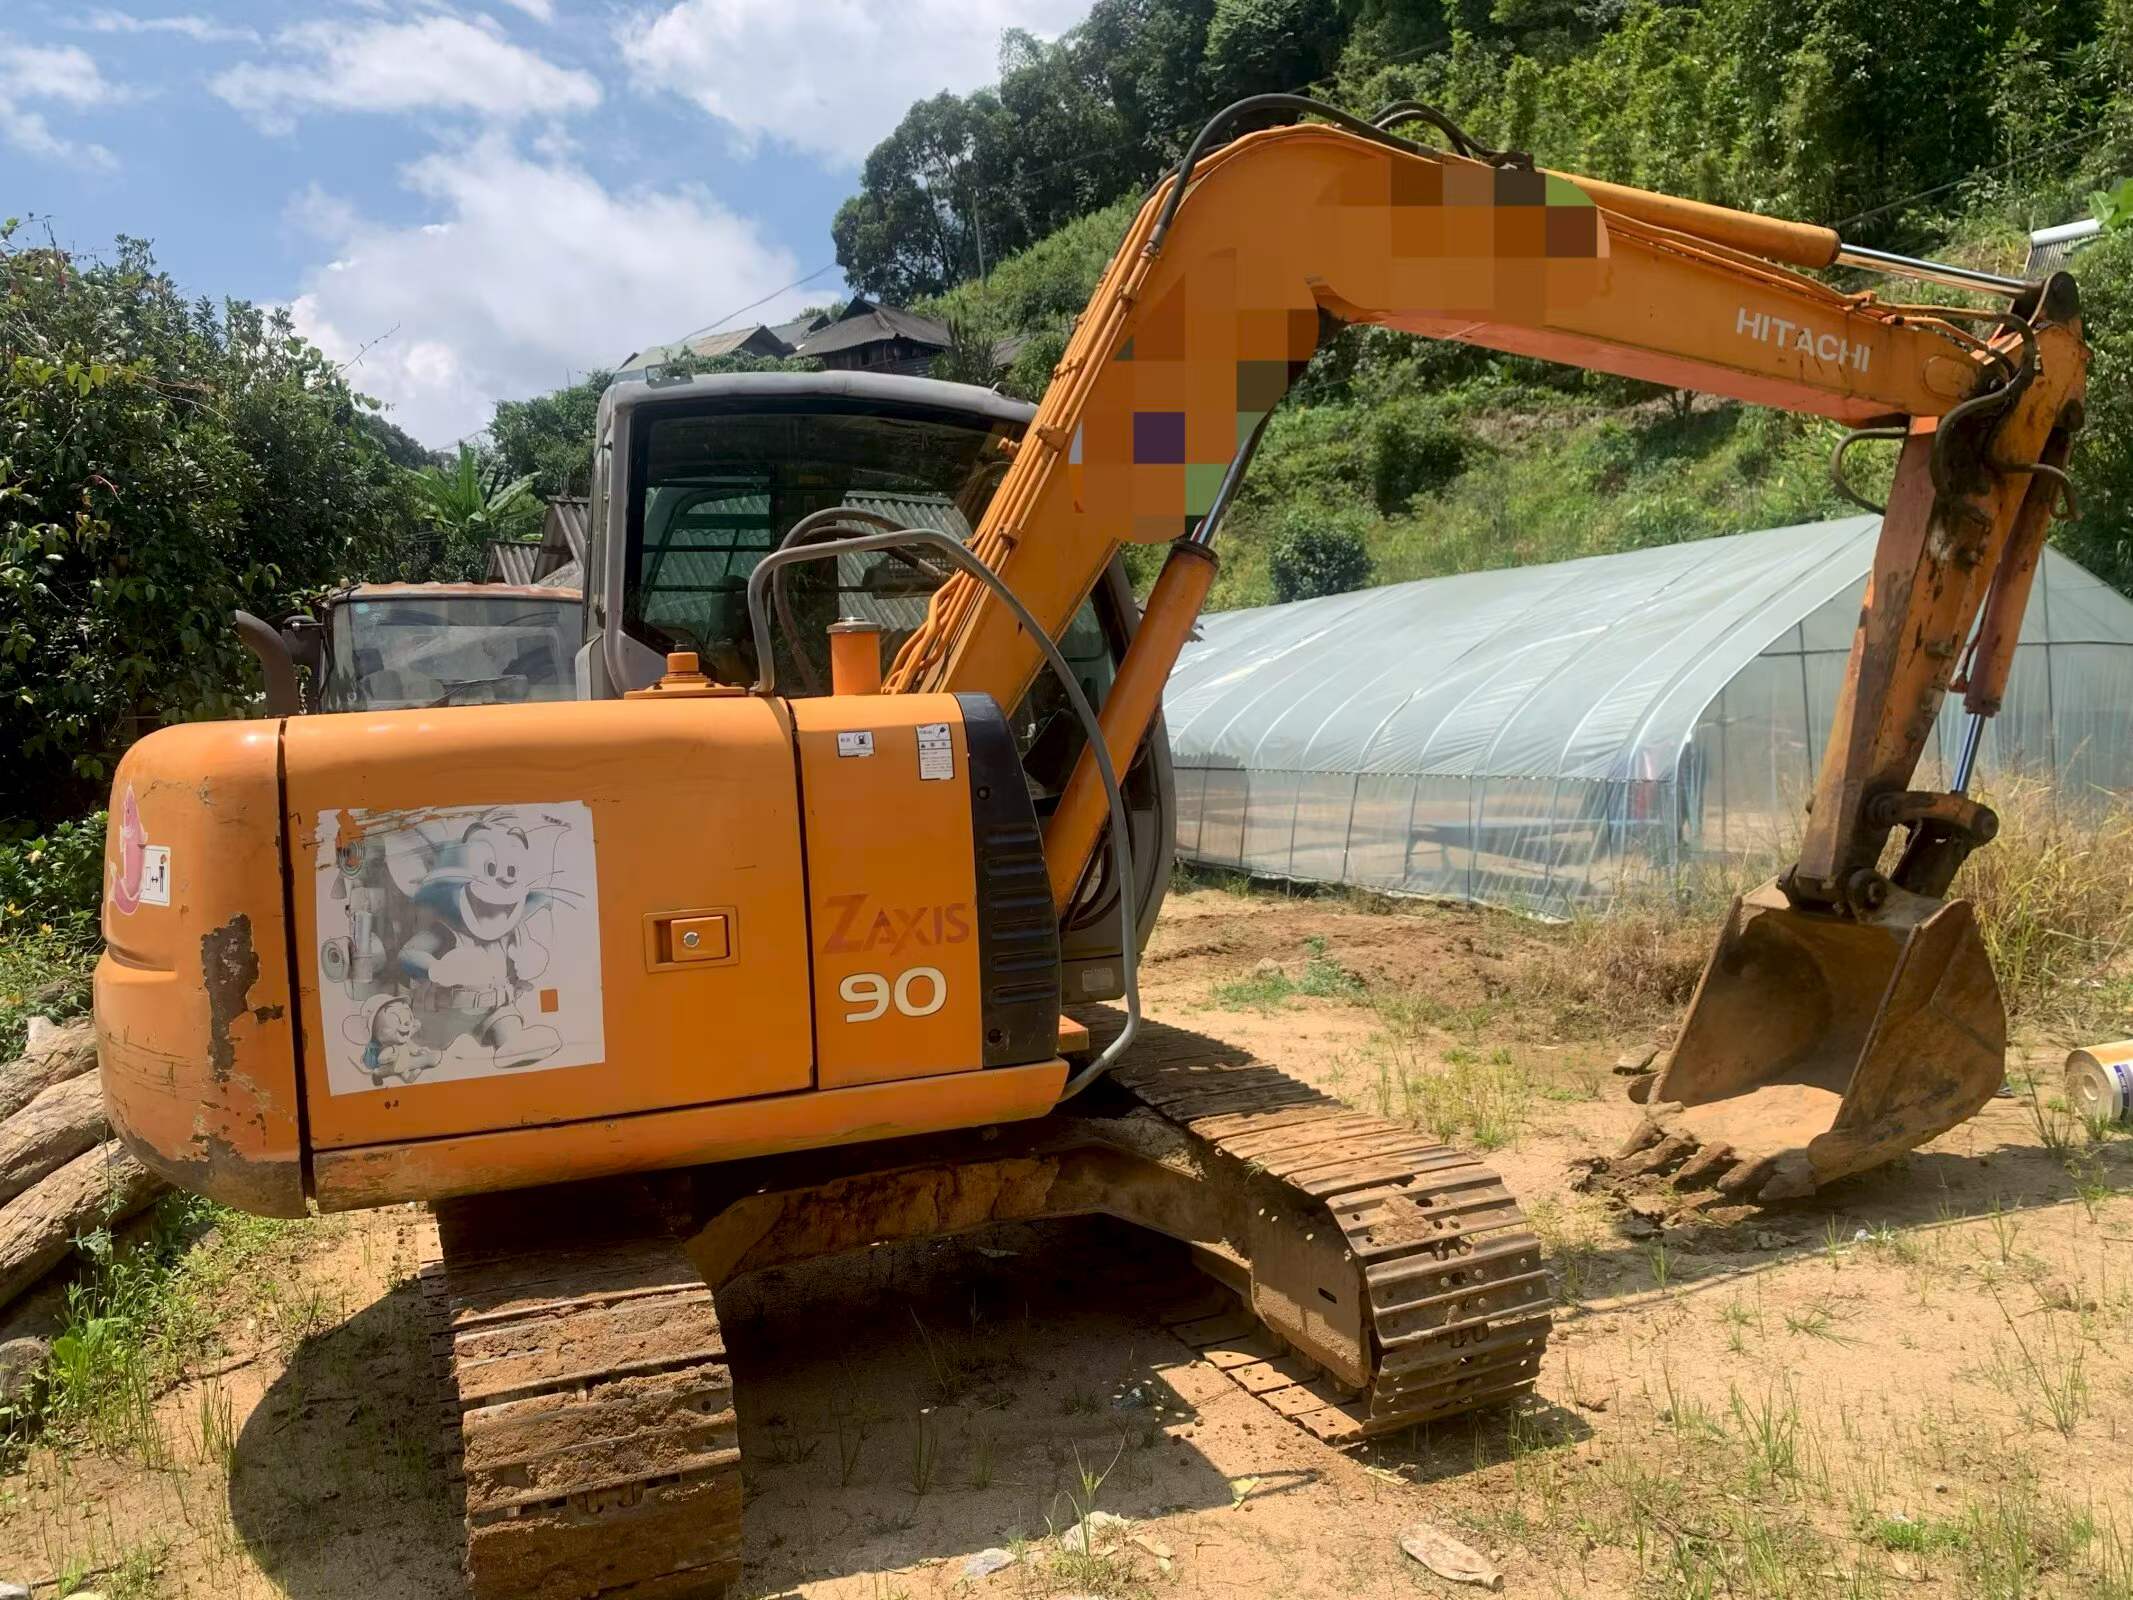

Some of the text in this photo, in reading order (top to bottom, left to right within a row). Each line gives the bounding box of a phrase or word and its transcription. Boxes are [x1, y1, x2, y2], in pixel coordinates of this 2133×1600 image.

[1736, 307, 1871, 373] HITACHI
[823, 893, 970, 956] ZAXIS
[838, 966, 947, 1023] 90
